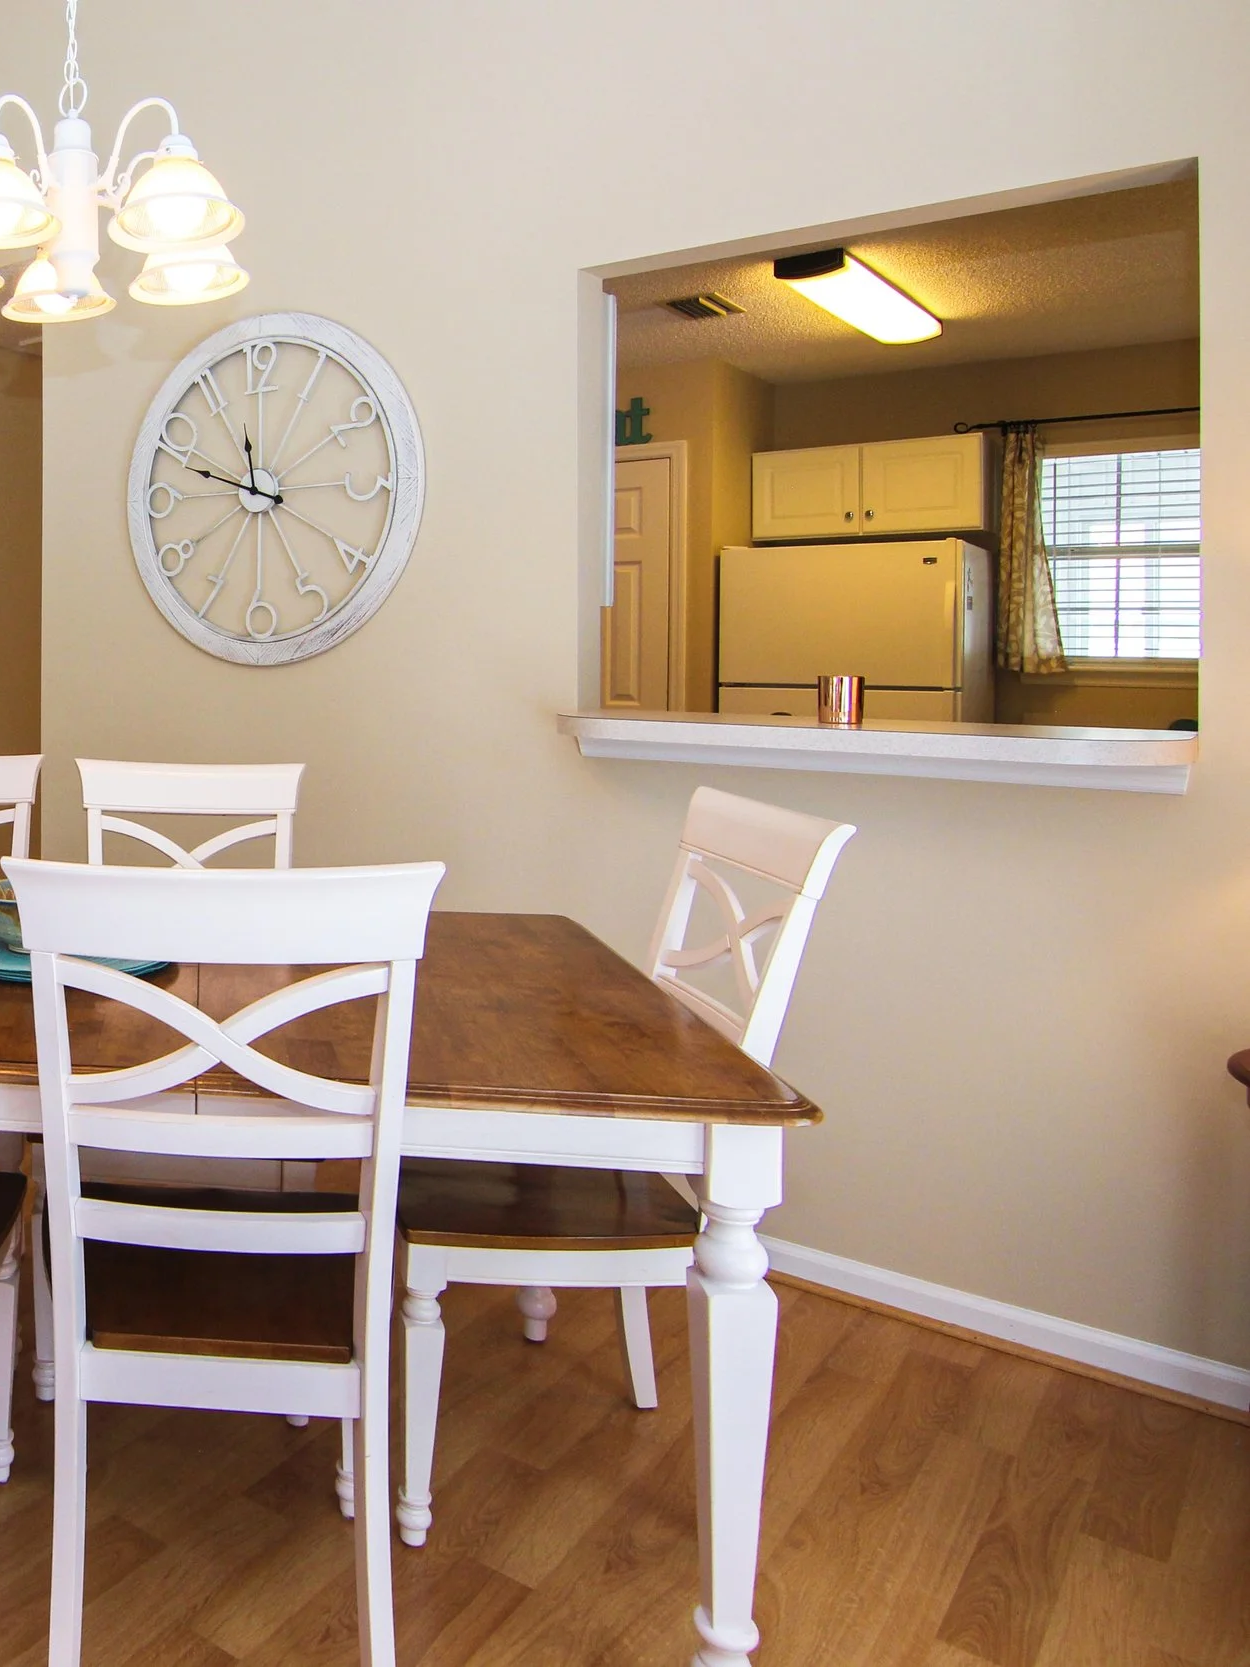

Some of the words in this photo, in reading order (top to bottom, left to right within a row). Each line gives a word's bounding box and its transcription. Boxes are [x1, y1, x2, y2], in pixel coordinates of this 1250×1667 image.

[194, 367, 229, 416] 11
[242, 341, 279, 396] 12
[297, 350, 327, 402] 1
[155, 411, 198, 468] 10
[330, 395, 378, 448] 2
[147, 481, 184, 520] 9
[344, 471, 394, 502] 3
[157, 538, 196, 578] 8
[332, 536, 380, 574] 4
[198, 573, 225, 619] 7
[246, 587, 278, 640] 6
[295, 571, 329, 623] 5
